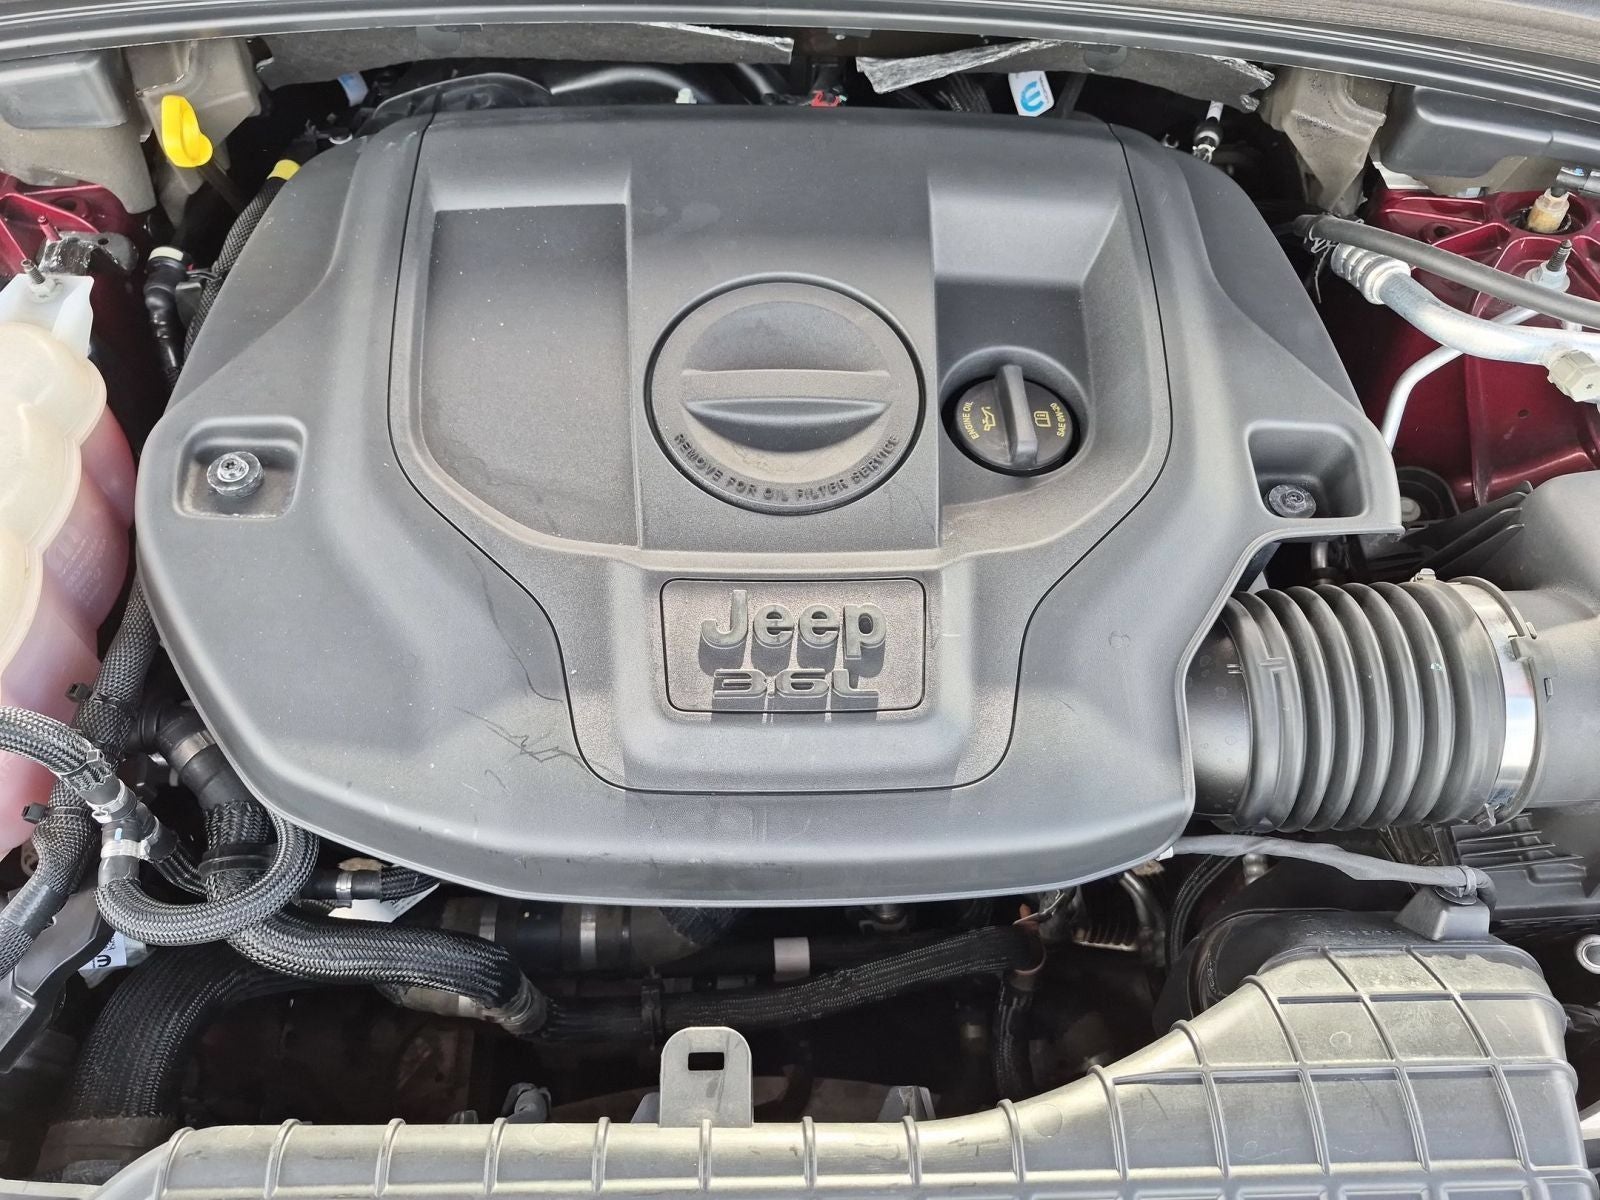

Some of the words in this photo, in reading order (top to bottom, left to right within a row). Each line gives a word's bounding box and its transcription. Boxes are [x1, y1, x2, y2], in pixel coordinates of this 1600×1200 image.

[962, 401, 974, 412] OIL
[962, 413, 980, 440] ENGINE
[1056, 423, 1066, 438] SAE
[674, 434, 724, 480] REMOVE
[725, 475, 758, 498] FOR
[763, 486, 789, 502] OIL
[797, 477, 849, 500] FILTER
[850, 435, 899, 485] SERVICE
[700, 589, 888, 661] Jeep
